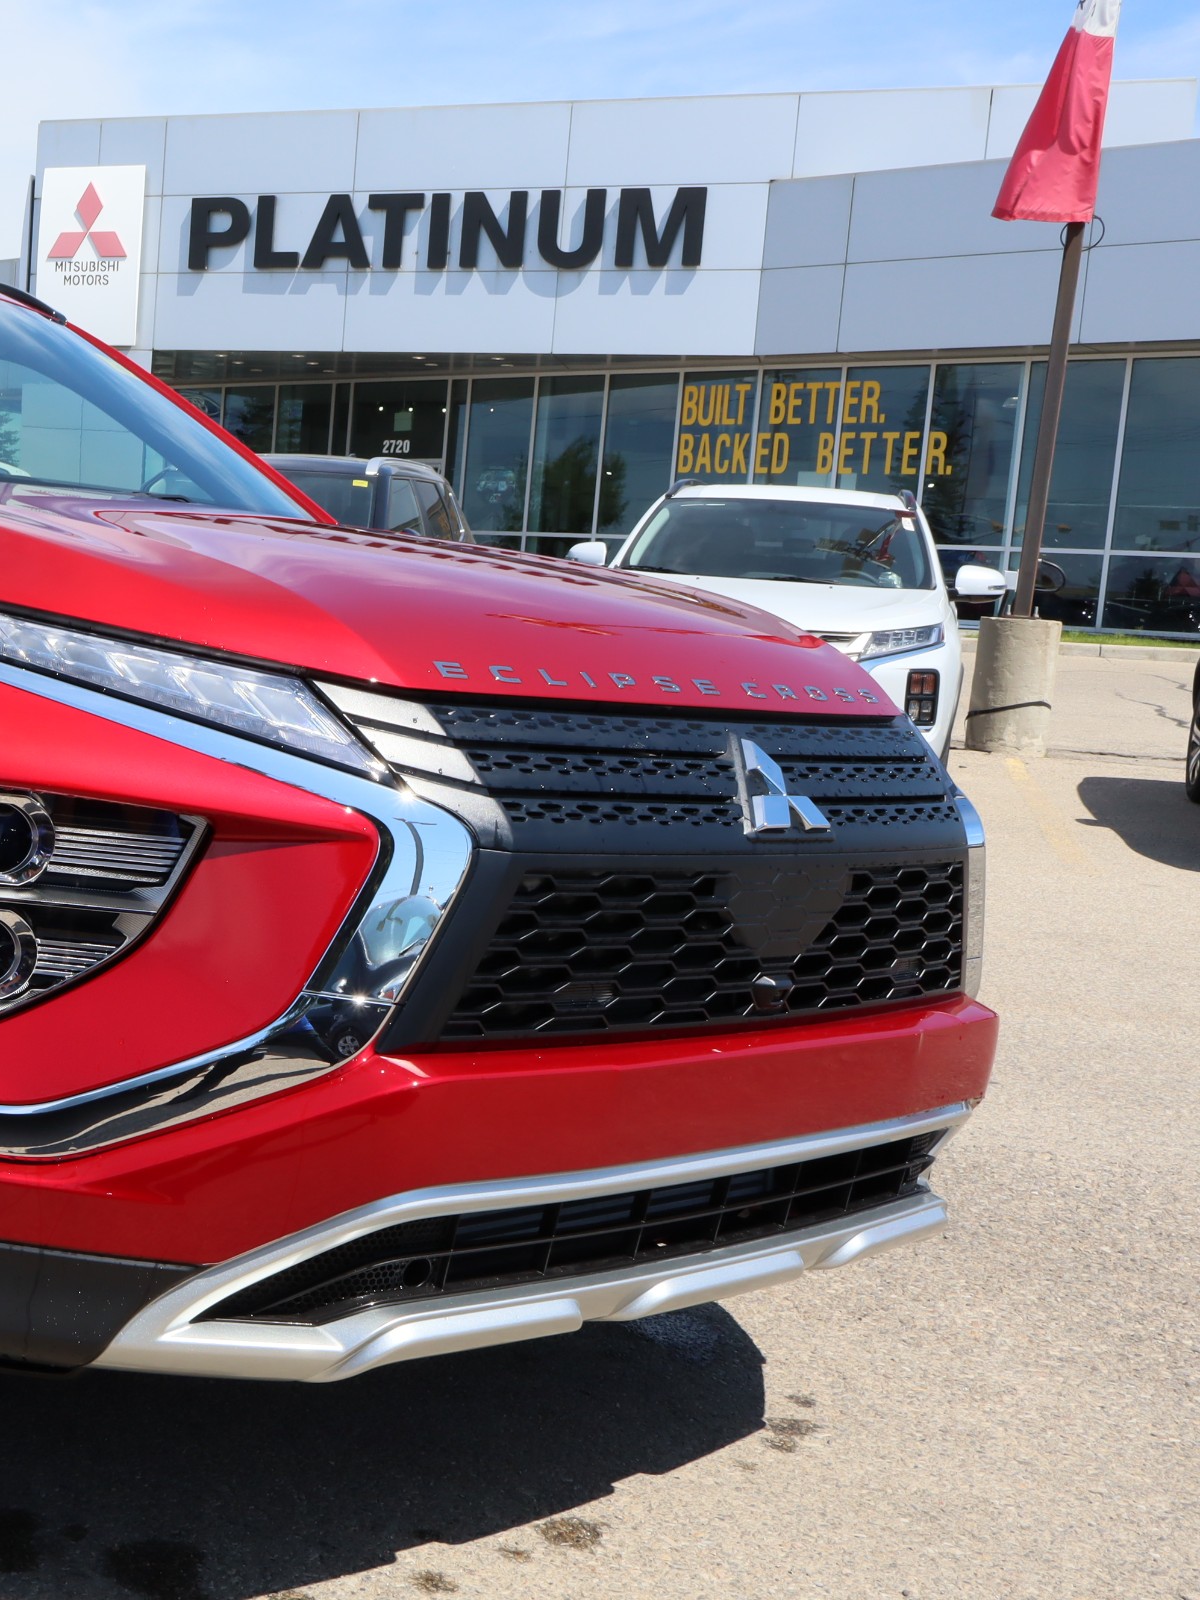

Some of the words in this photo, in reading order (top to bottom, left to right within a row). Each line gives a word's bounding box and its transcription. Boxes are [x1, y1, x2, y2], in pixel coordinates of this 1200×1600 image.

[187, 186, 708, 271] PLATINUM
[55, 260, 119, 272] MITSUBISHI
[63, 274, 109, 286] MOTORS
[681, 383, 752, 426] BUILT
[768, 380, 886, 425] BETTER.
[382, 439, 410, 454] 2720
[677, 432, 790, 474] BACKED
[815, 431, 953, 475] BETTER.
[431, 660, 721, 696] ECLIPSE
[740, 682, 879, 704] CROSS
